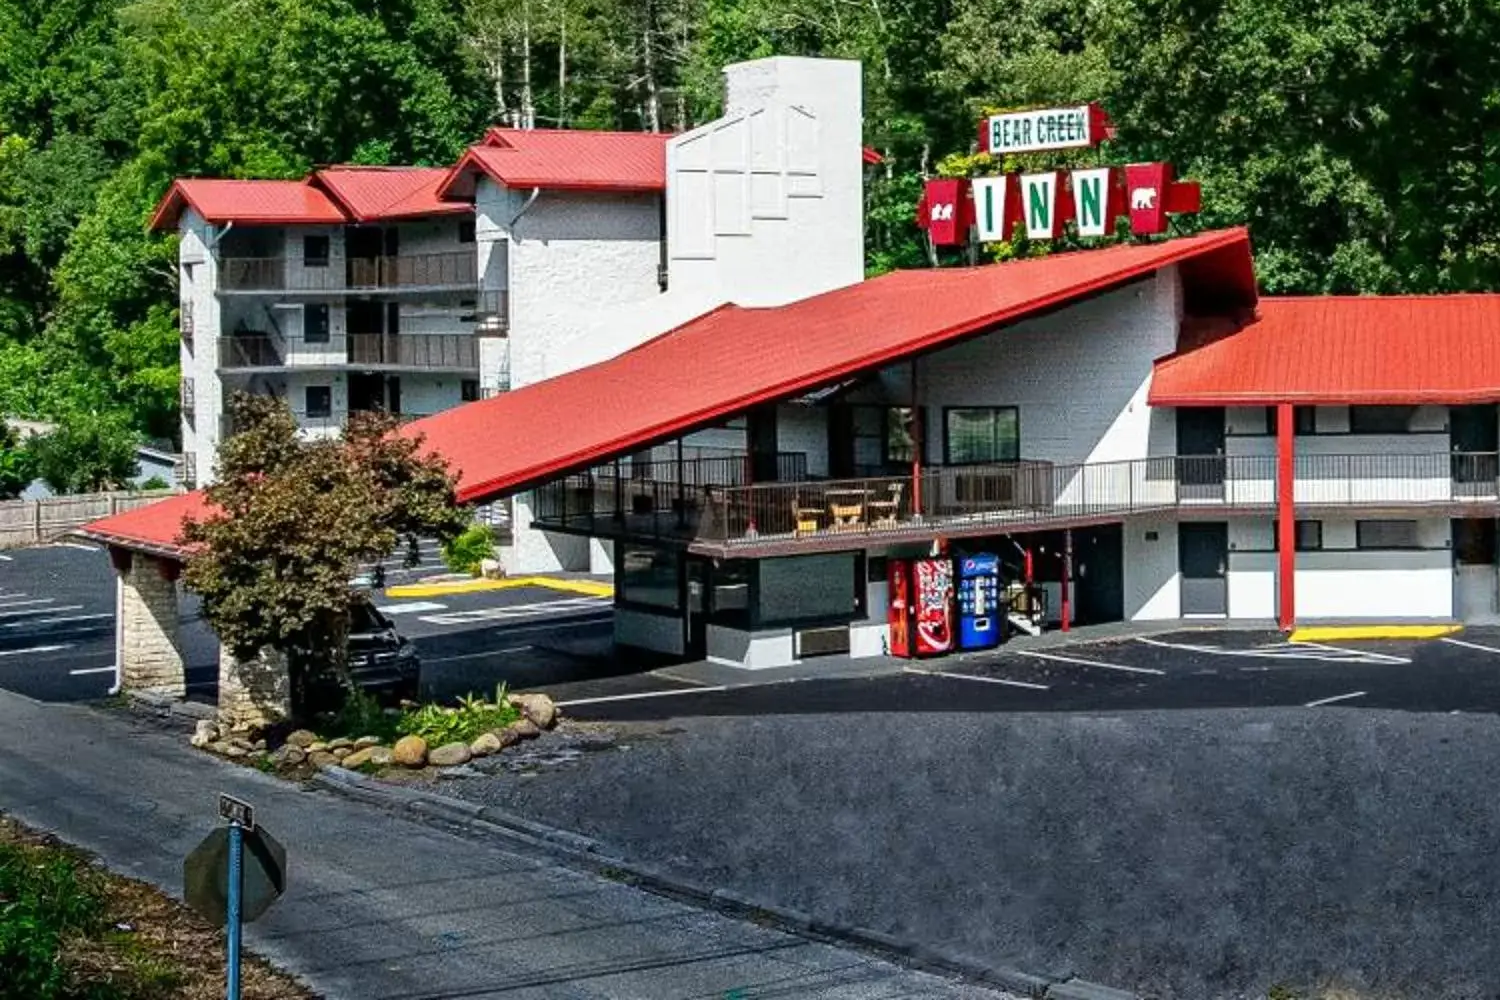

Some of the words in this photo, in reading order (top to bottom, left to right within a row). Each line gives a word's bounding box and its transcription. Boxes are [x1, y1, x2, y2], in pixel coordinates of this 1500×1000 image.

[993, 118, 1032, 148] BEAR
[1037, 112, 1086, 144] CREEK
[985, 177, 1101, 232] INN
